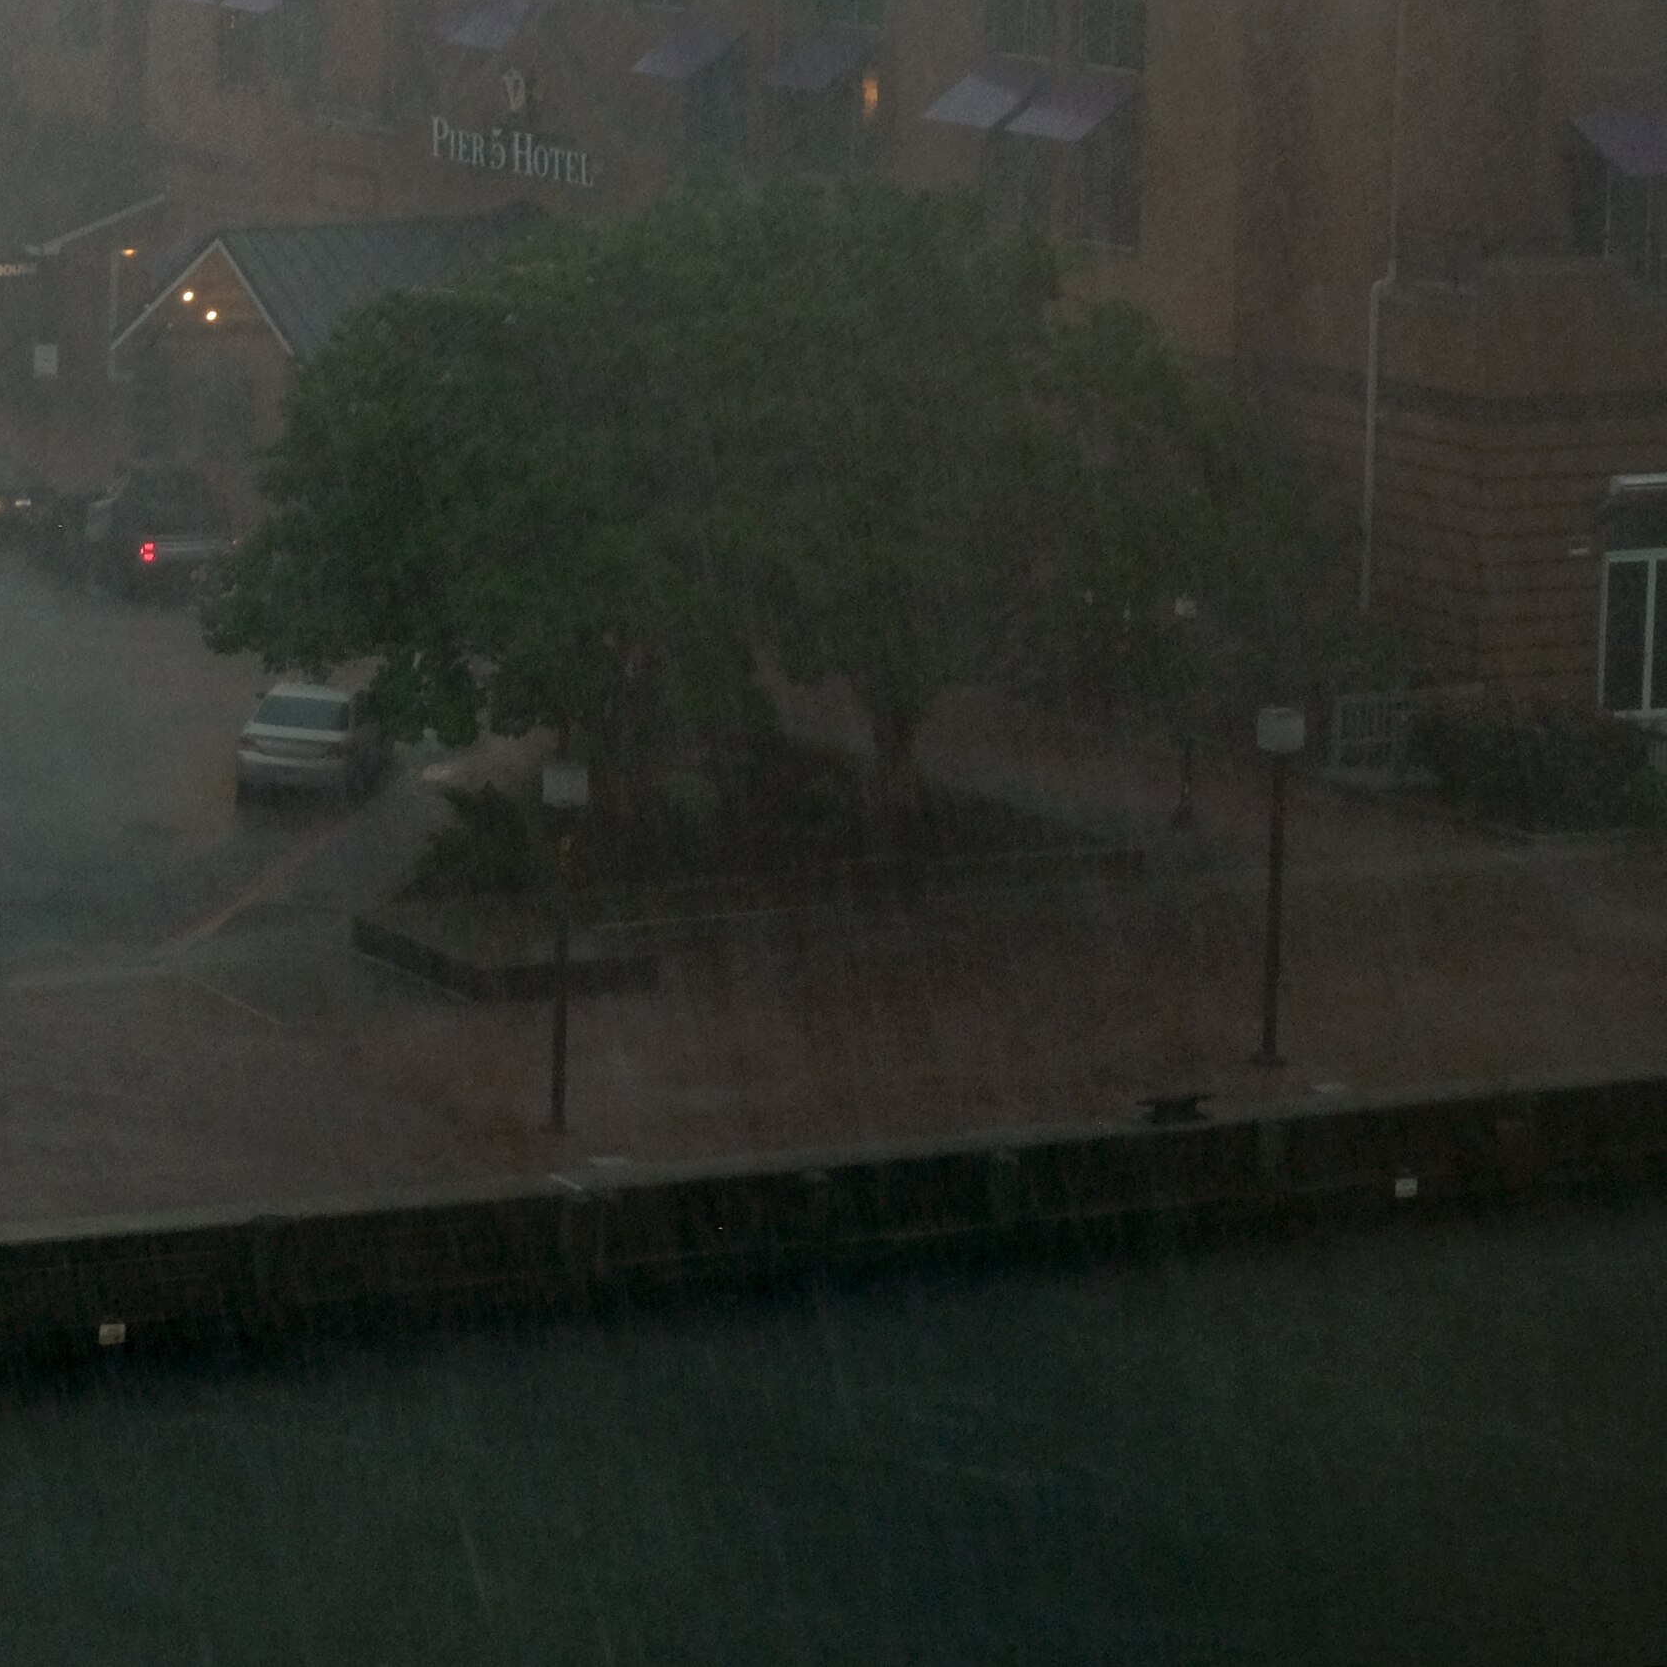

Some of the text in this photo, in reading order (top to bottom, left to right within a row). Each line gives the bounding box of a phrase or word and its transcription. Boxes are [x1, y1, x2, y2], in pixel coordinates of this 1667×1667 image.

[432, 116, 593, 186] PIER 5 HOTEL
